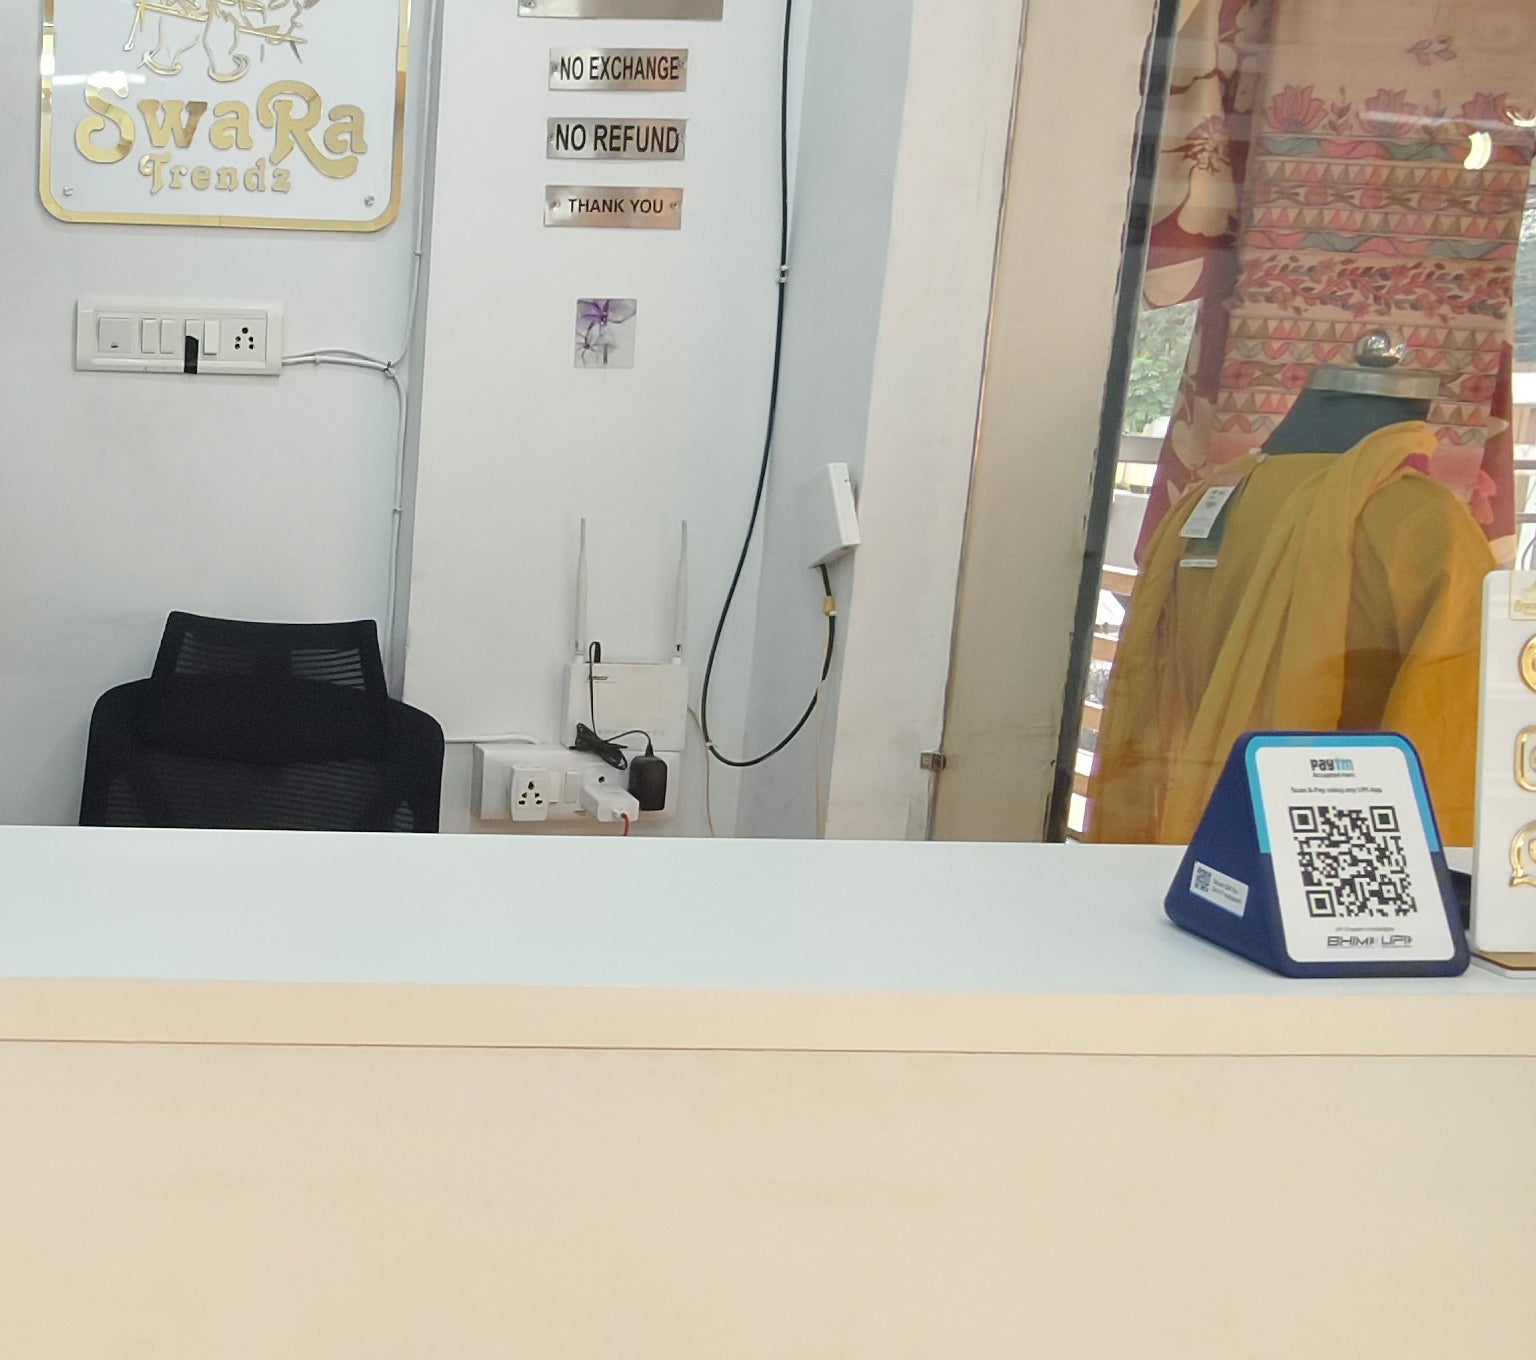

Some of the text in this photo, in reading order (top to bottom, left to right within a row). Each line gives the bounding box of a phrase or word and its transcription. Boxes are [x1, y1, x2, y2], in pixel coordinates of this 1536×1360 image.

[559, 56, 680, 81] NO EXCHANGE
[75, 70, 368, 179] SwaRa
[555, 124, 680, 154] NO REFUND
[138, 152, 292, 195] Trendz
[568, 198, 664, 215] THANK YOU
[1327, 934, 1409, 947] BHIM UPI
